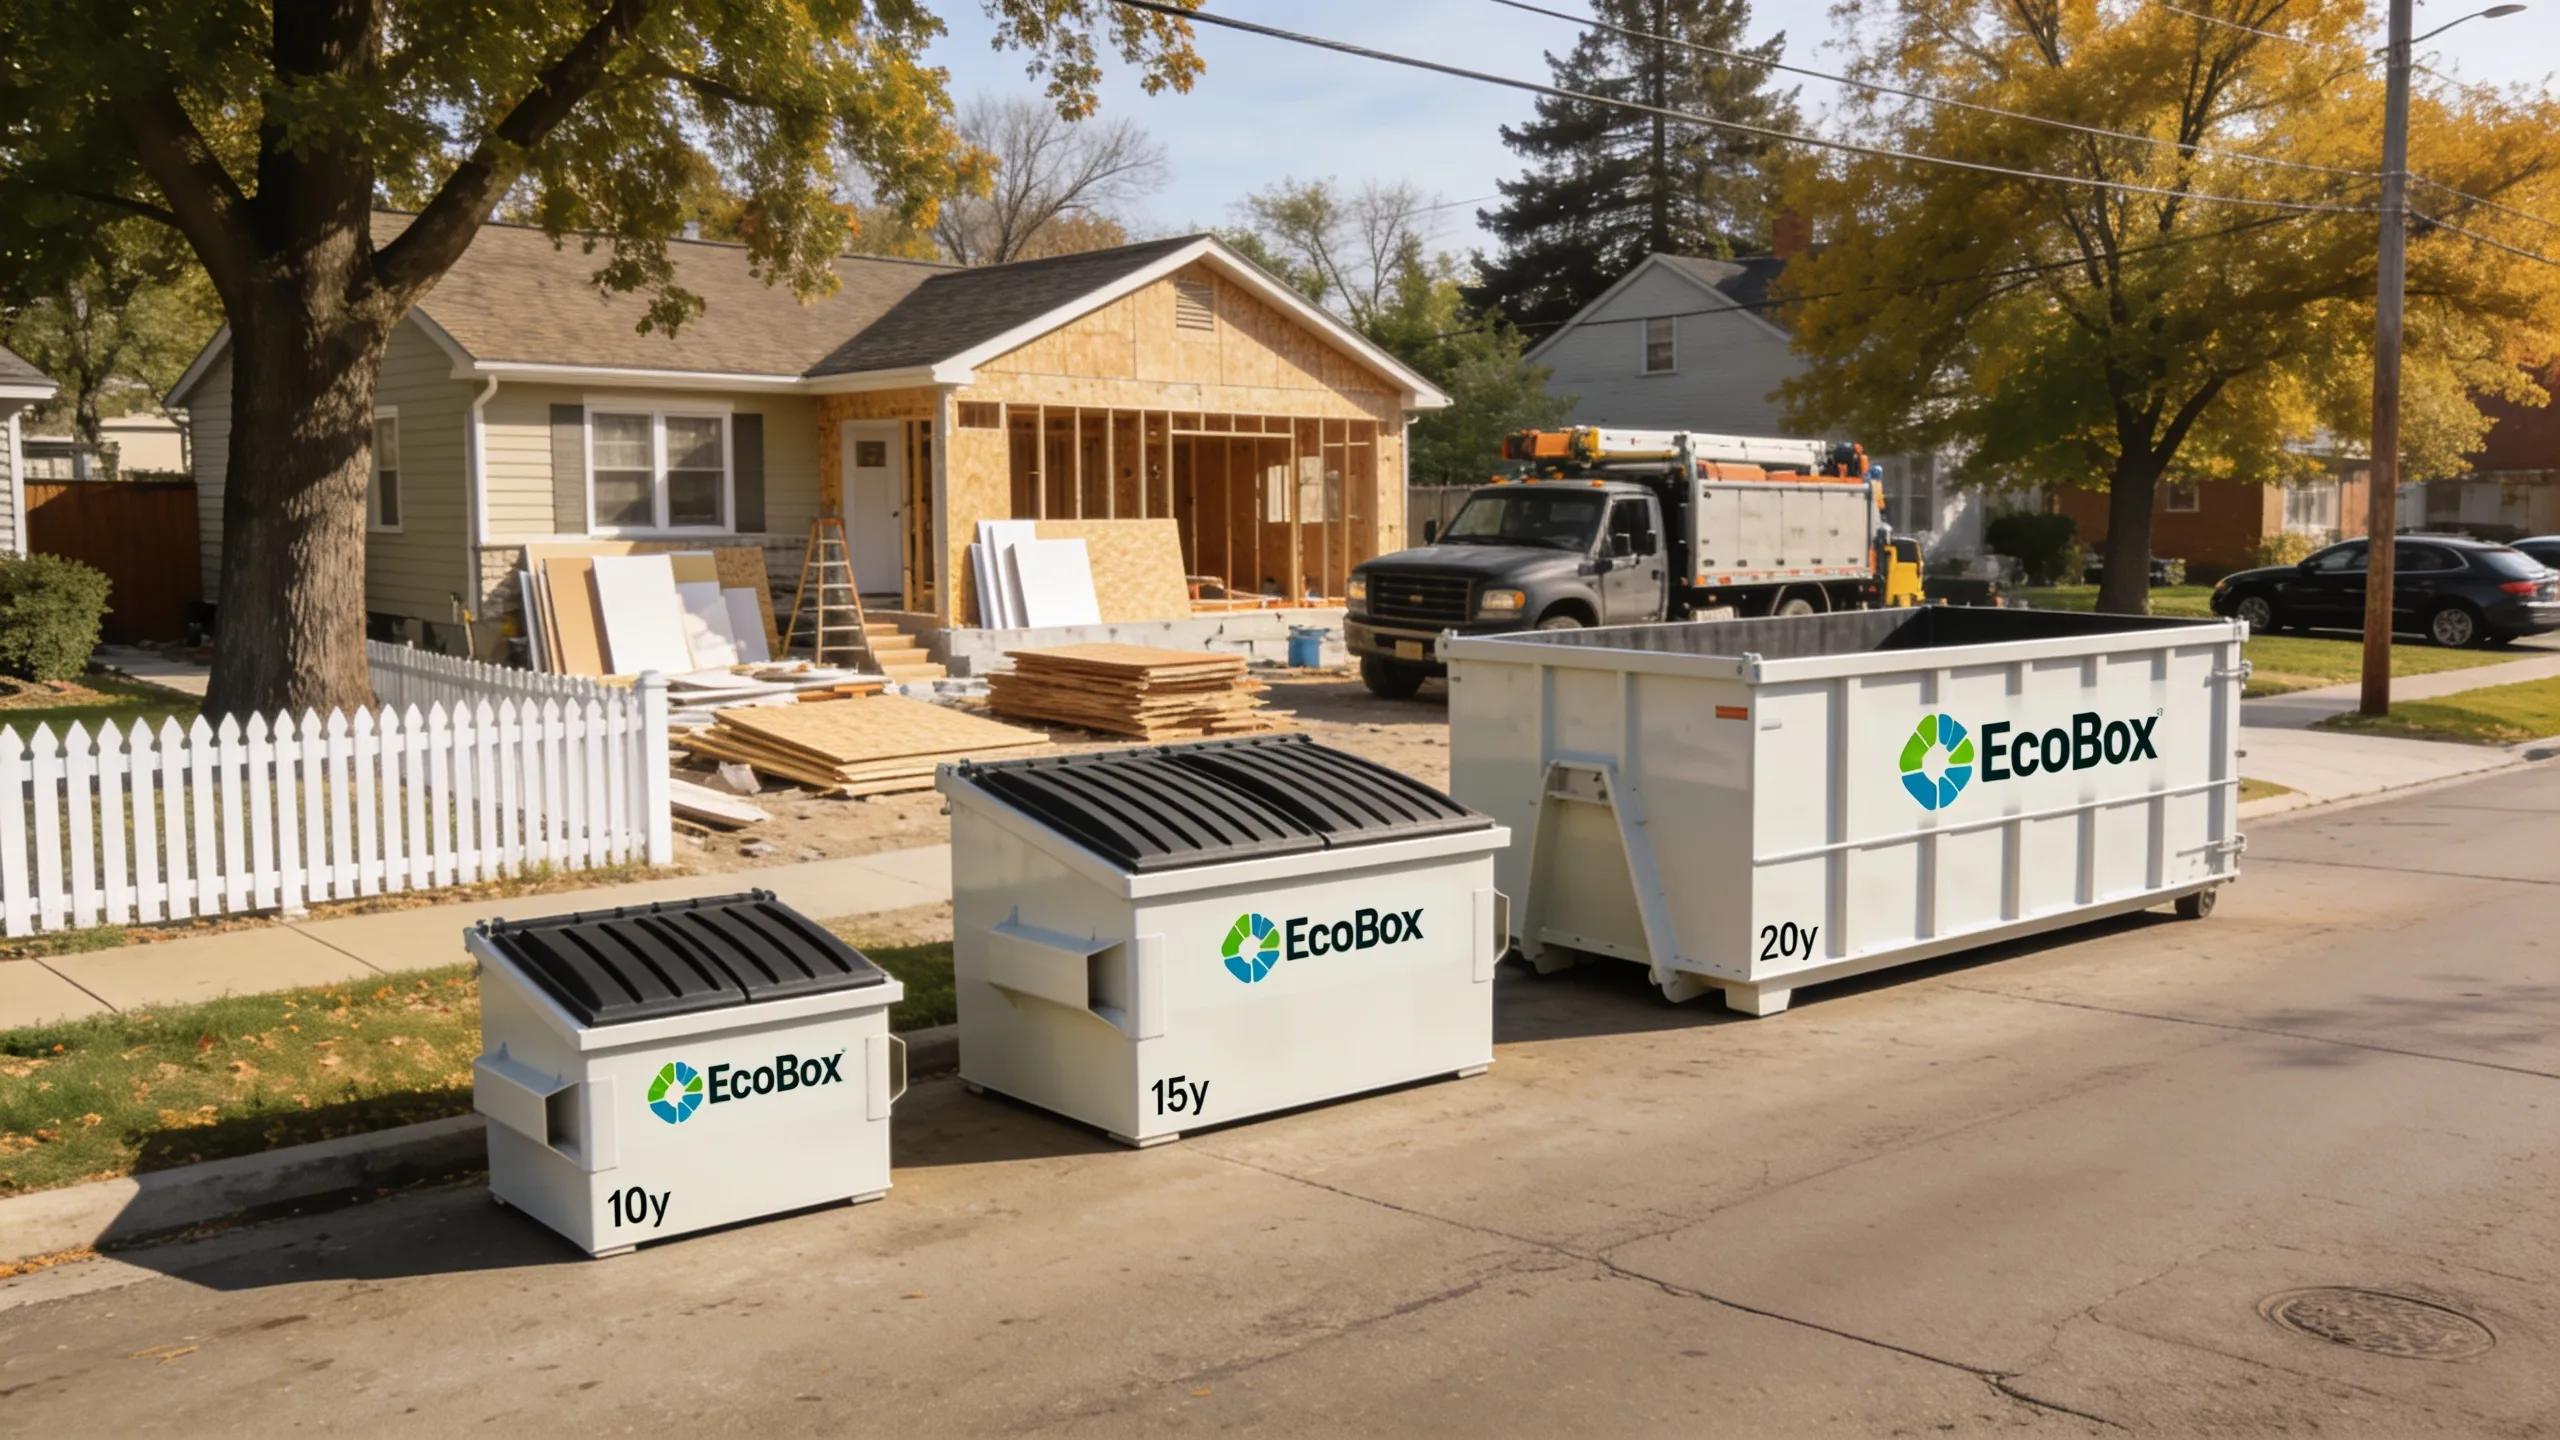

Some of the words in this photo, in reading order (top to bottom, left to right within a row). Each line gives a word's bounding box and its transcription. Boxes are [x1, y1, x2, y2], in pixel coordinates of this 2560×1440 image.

[1981, 711, 2159, 783] EcoBox
[1285, 907, 1424, 962] EcoBox
[1760, 921, 1819, 961] 20y
[708, 1054, 843, 1105] EcoBox
[1151, 1075, 1210, 1116] 15y
[607, 1186, 671, 1228] 10y
